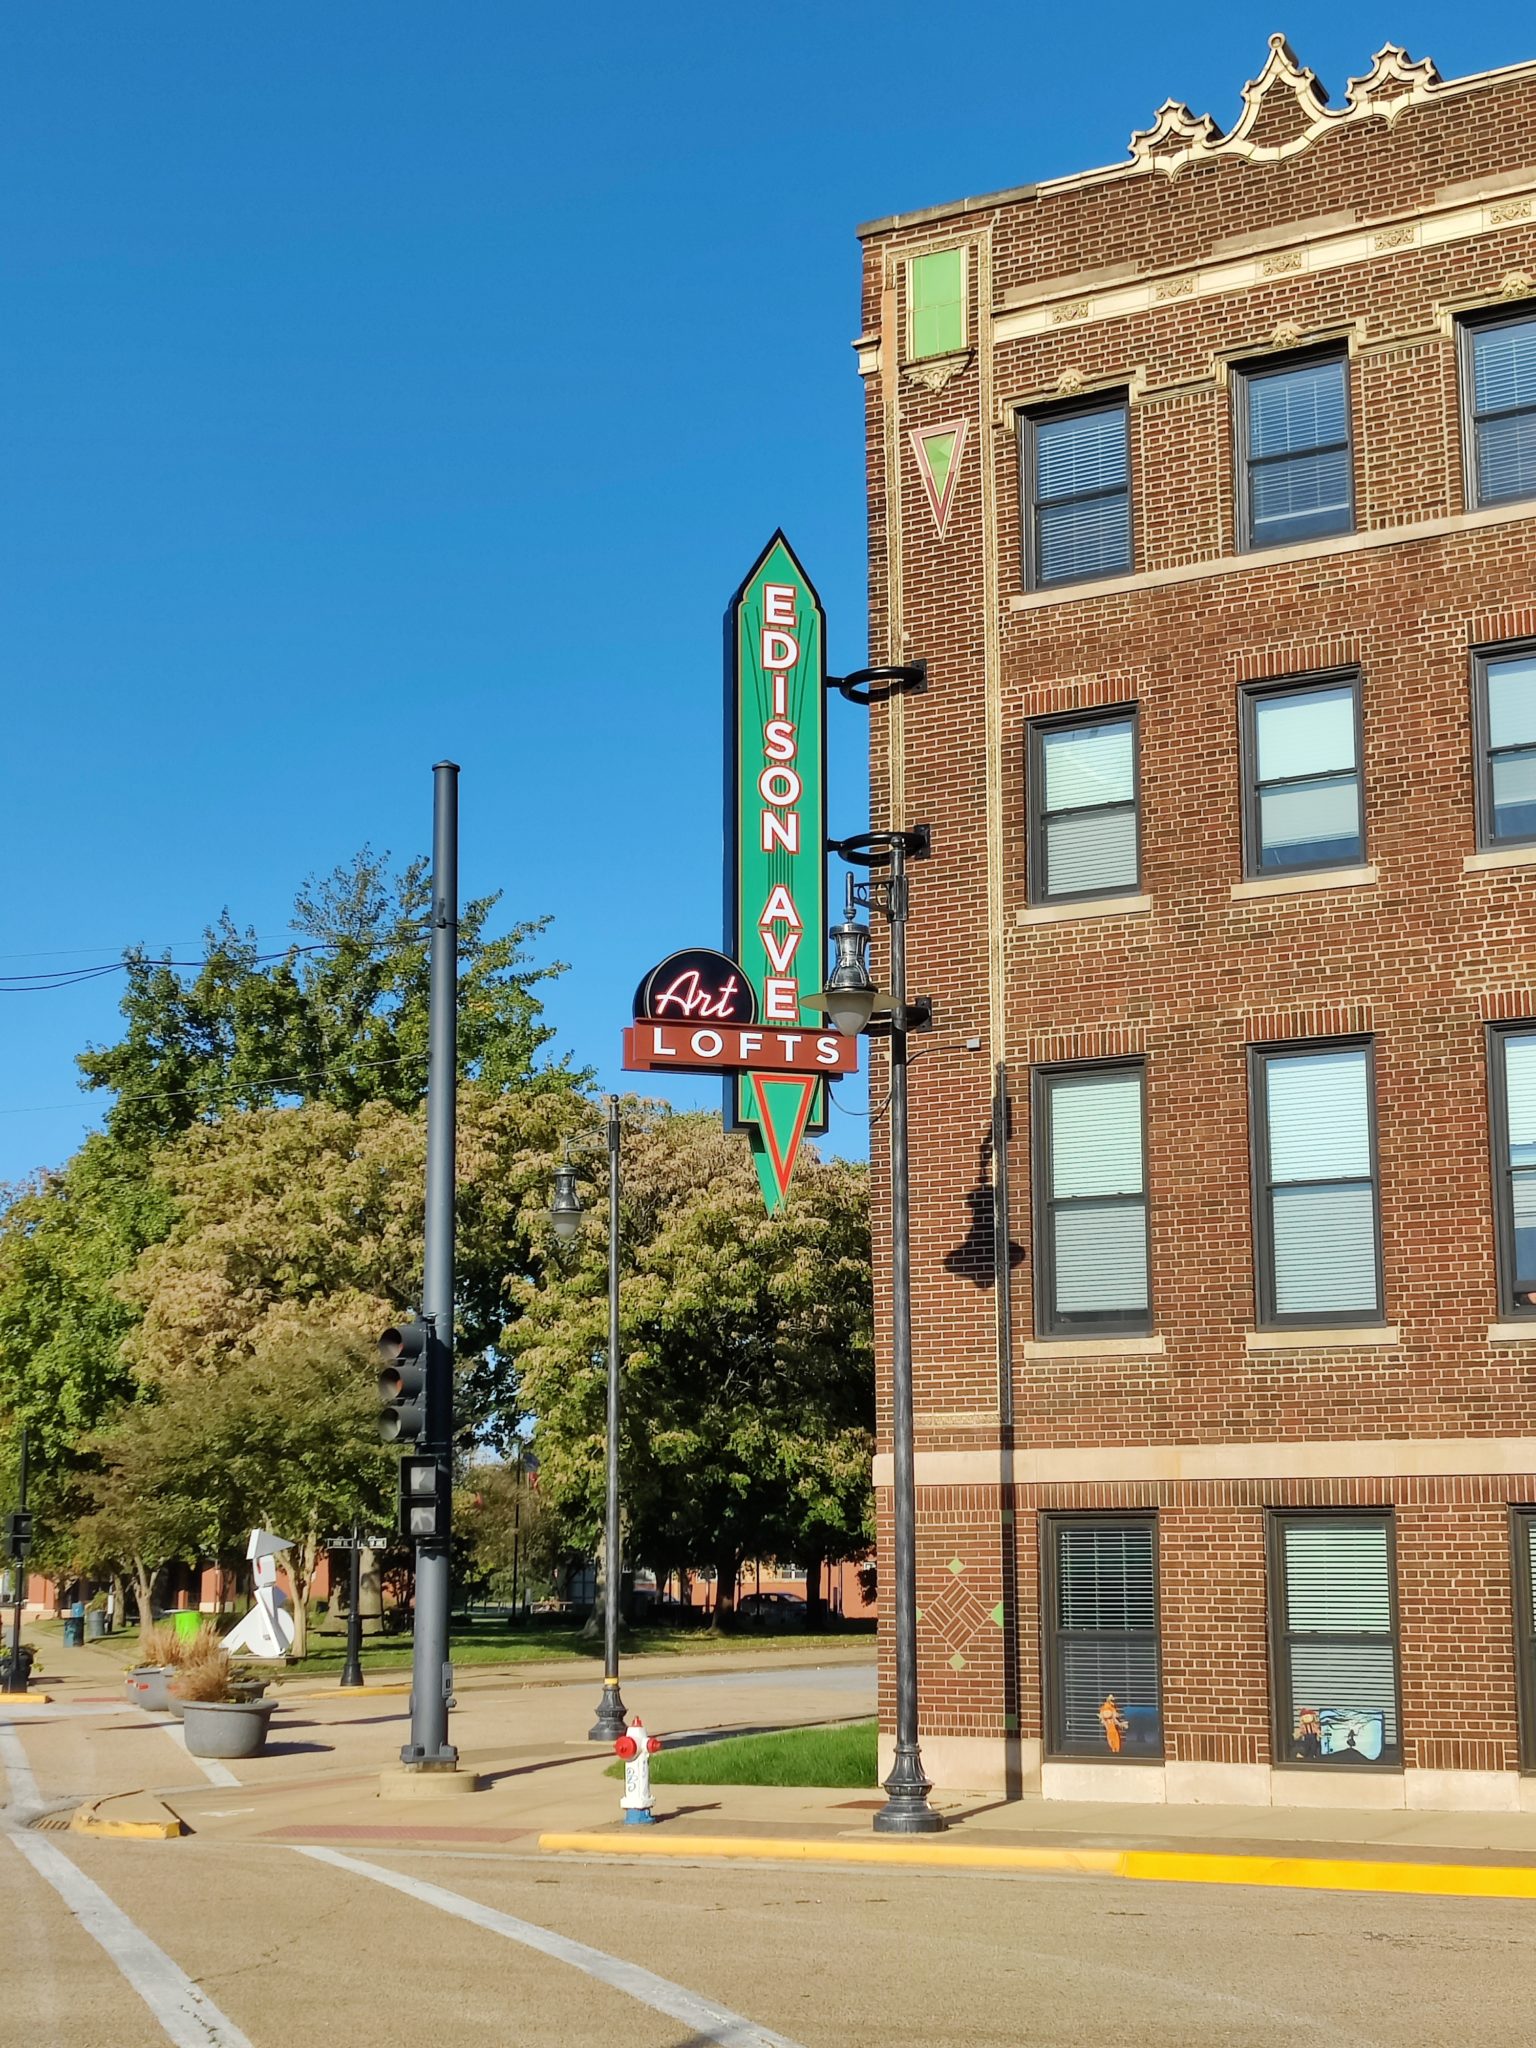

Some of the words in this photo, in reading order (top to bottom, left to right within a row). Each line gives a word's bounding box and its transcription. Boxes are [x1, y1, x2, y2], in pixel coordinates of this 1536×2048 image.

[758, 583, 802, 854] EDISON
[654, 970, 738, 1018] Art
[759, 884, 803, 1021] AVE
[652, 1026, 841, 1065] LOFTS
